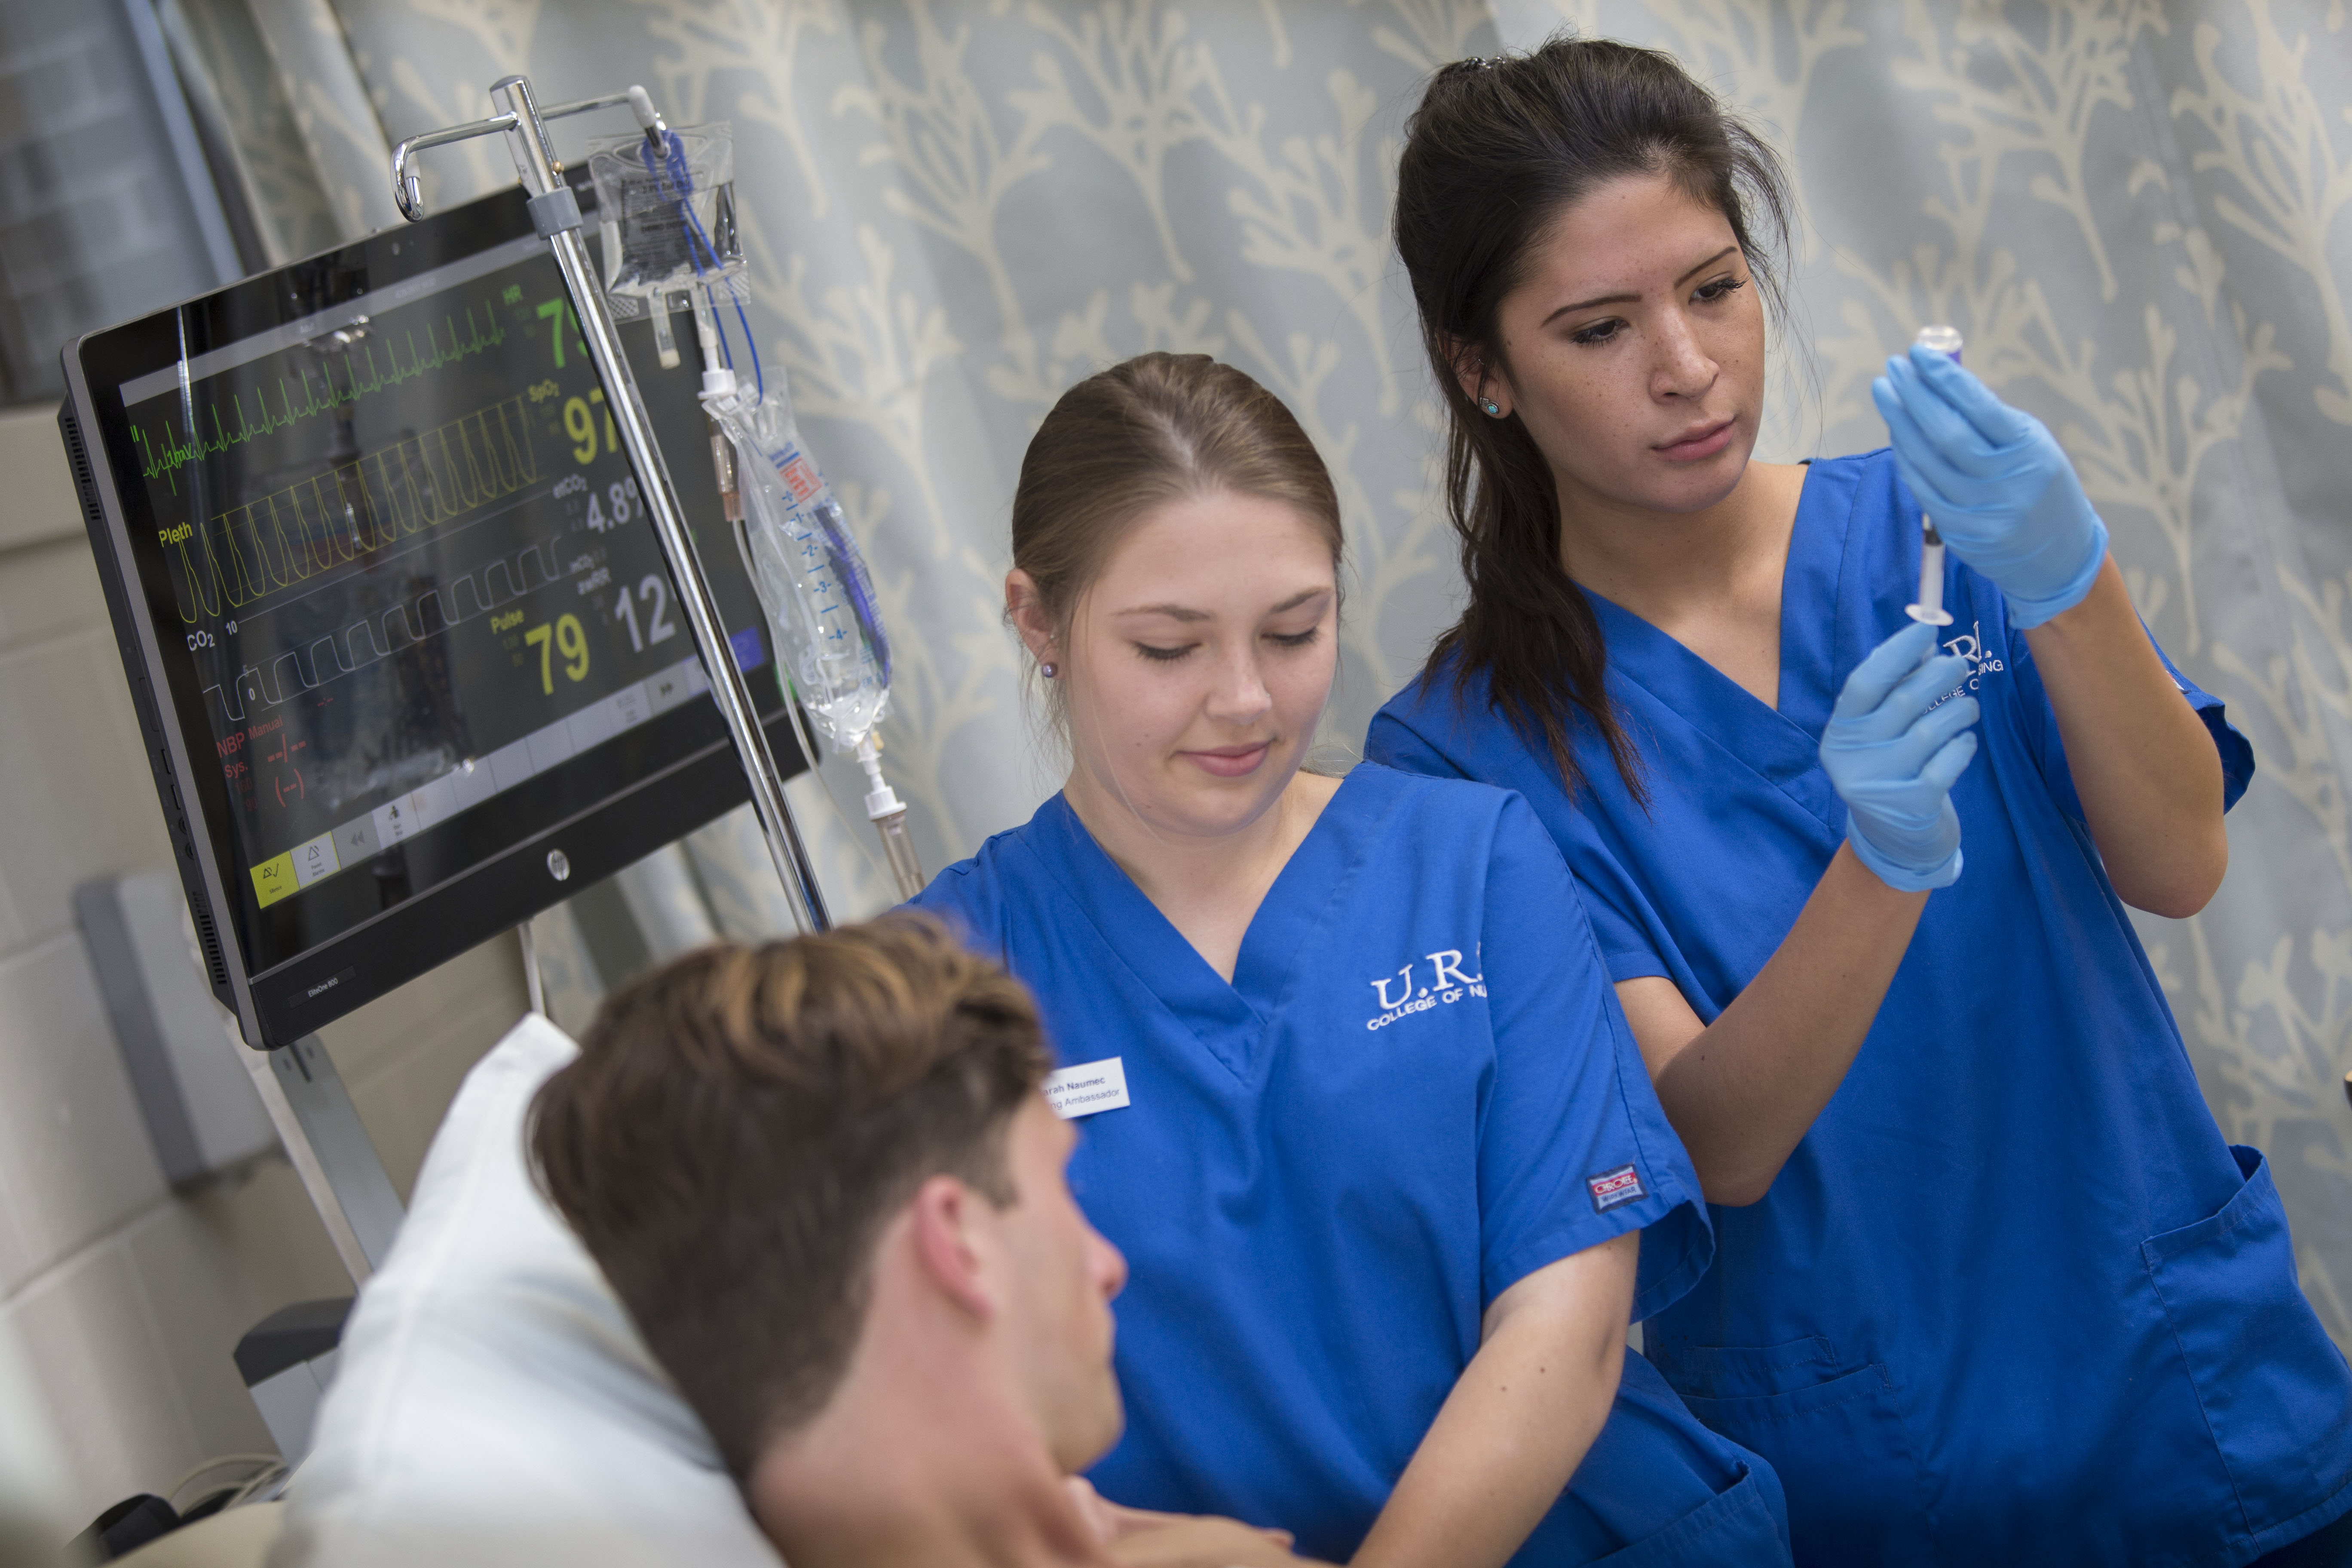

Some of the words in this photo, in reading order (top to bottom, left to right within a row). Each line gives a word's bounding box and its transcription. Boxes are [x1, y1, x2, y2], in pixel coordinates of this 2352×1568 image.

[158, 521, 193, 548] Pleth
[490, 609, 524, 635] Pulse
[615, 573, 676, 653] 12
[226, 621, 237, 635] 10
[524, 612, 590, 696] 79
[217, 732, 245, 758] NBP
[248, 715, 283, 740] Manual
[225, 762, 248, 779] Sys.
[308, 984, 328, 997] EliteOne
[328, 977, 338, 987] 800
[1367, 995, 1437, 1031] COLLEGE
[1442, 988, 1463, 1004] OF
[1067, 1077, 1106, 1091] Naumec
[1065, 1089, 1120, 1106] Ambassador
